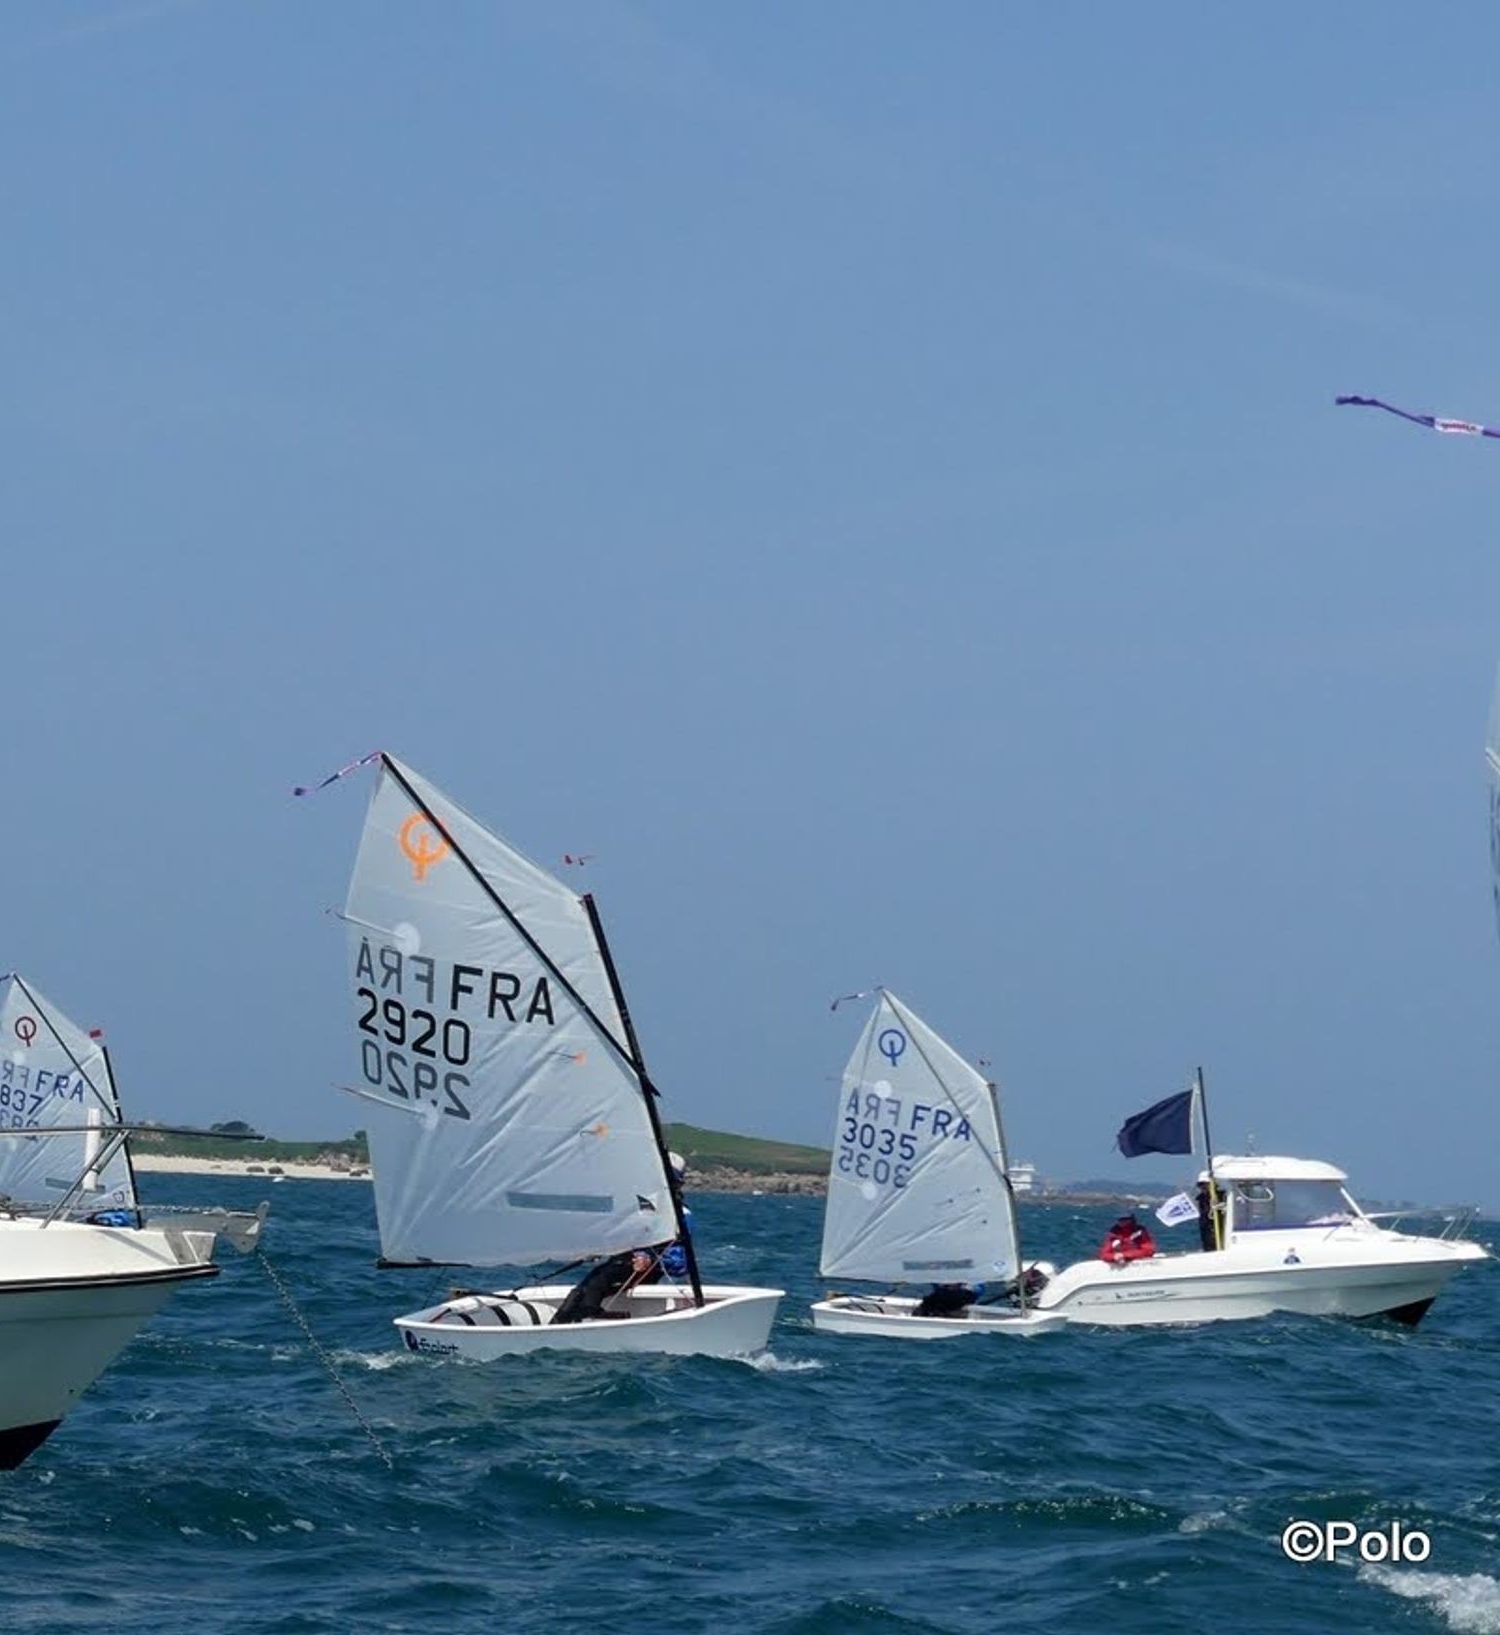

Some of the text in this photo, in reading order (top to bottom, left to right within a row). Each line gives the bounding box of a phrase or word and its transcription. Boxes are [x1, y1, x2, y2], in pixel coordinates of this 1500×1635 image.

[450, 963, 555, 1026] FRA
[357, 987, 471, 1066] 2920
[35, 1069, 84, 1103] FRA
[842, 1116, 918, 1161] 3035
[911, 1104, 971, 1142] FRA
